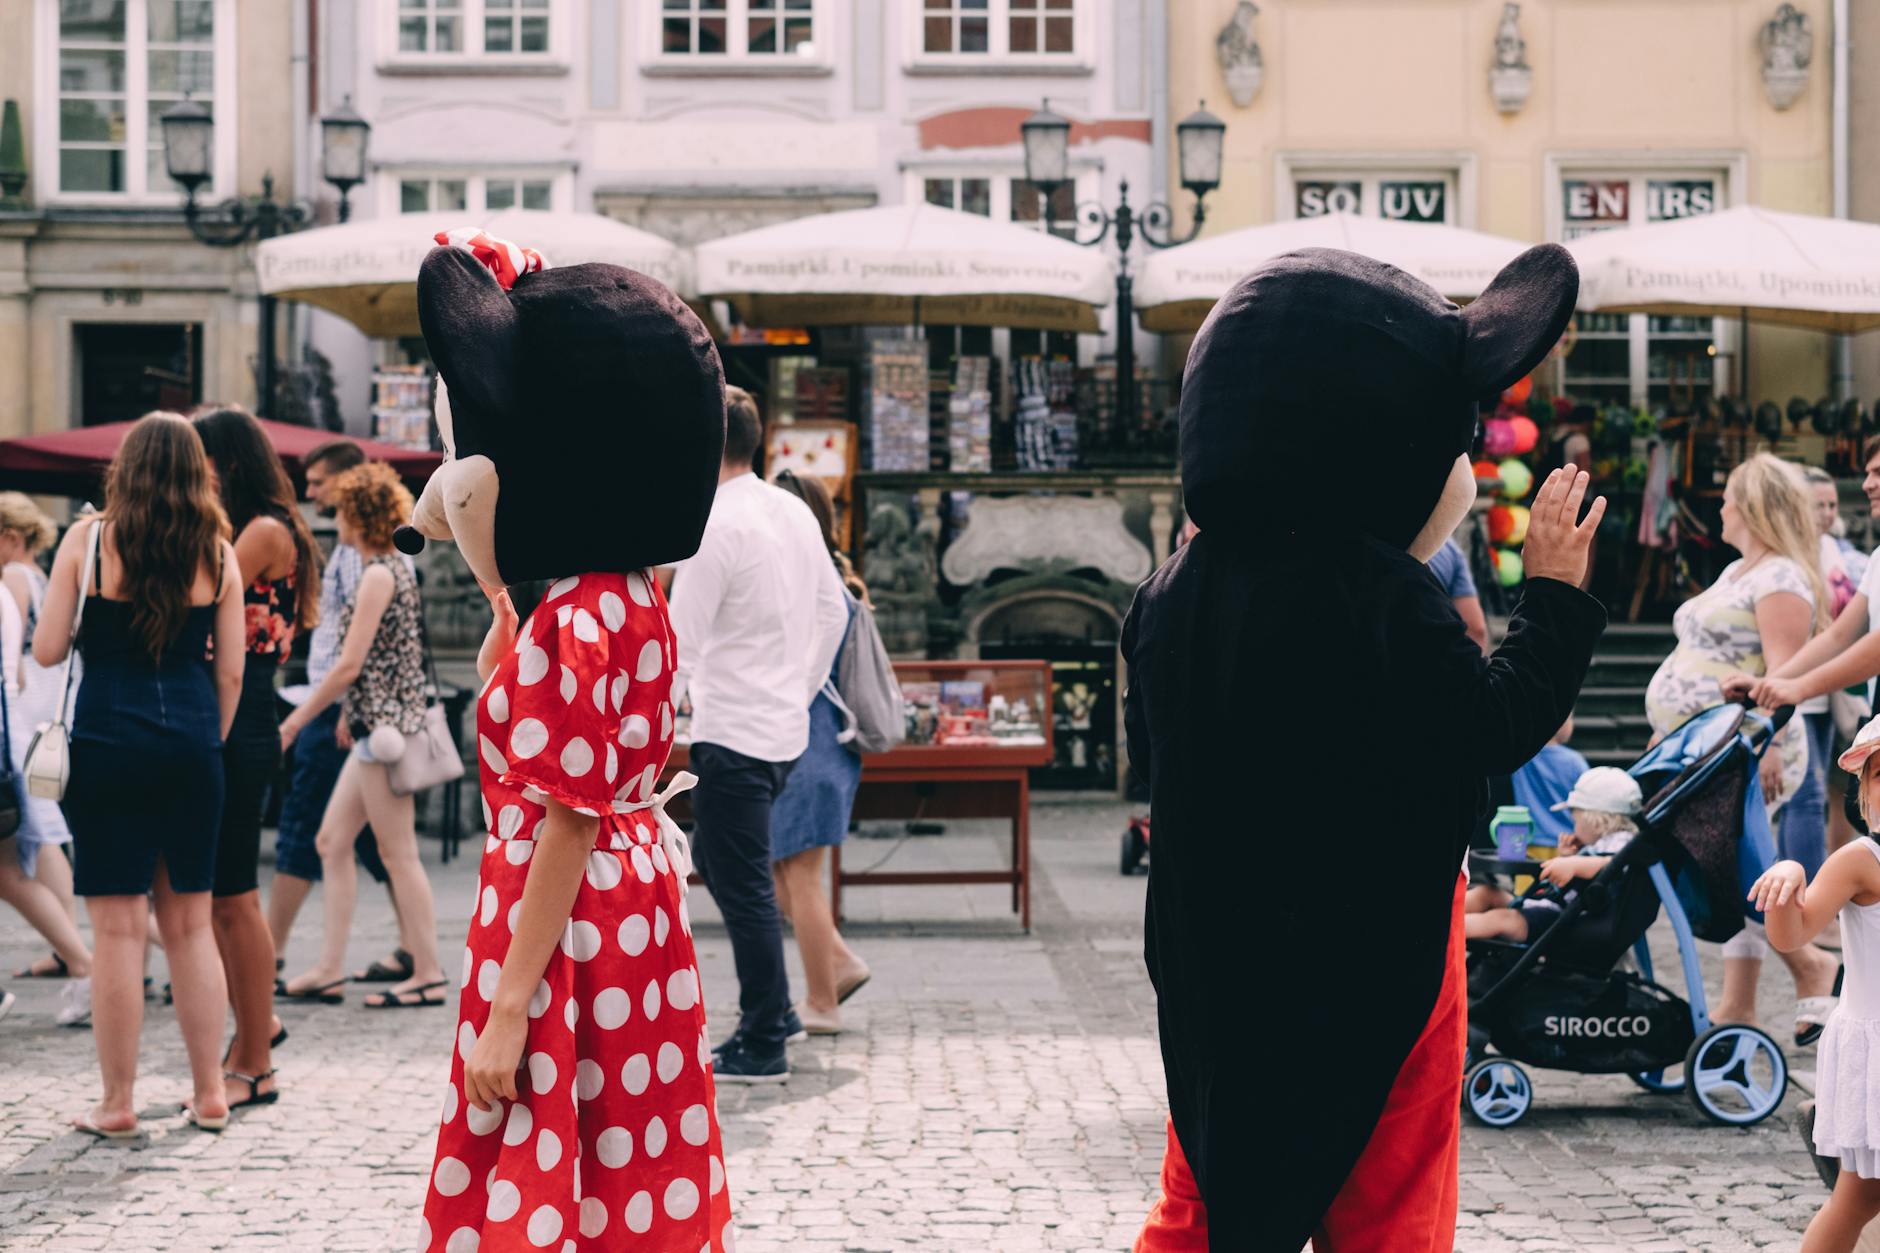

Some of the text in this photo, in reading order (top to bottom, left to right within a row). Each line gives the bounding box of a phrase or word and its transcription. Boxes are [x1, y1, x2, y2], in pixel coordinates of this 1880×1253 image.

[1302, 187, 1441, 218] SO UV
[1569, 186, 1713, 218] EN IRS
[1543, 1015, 1652, 1038] SIROCCO
